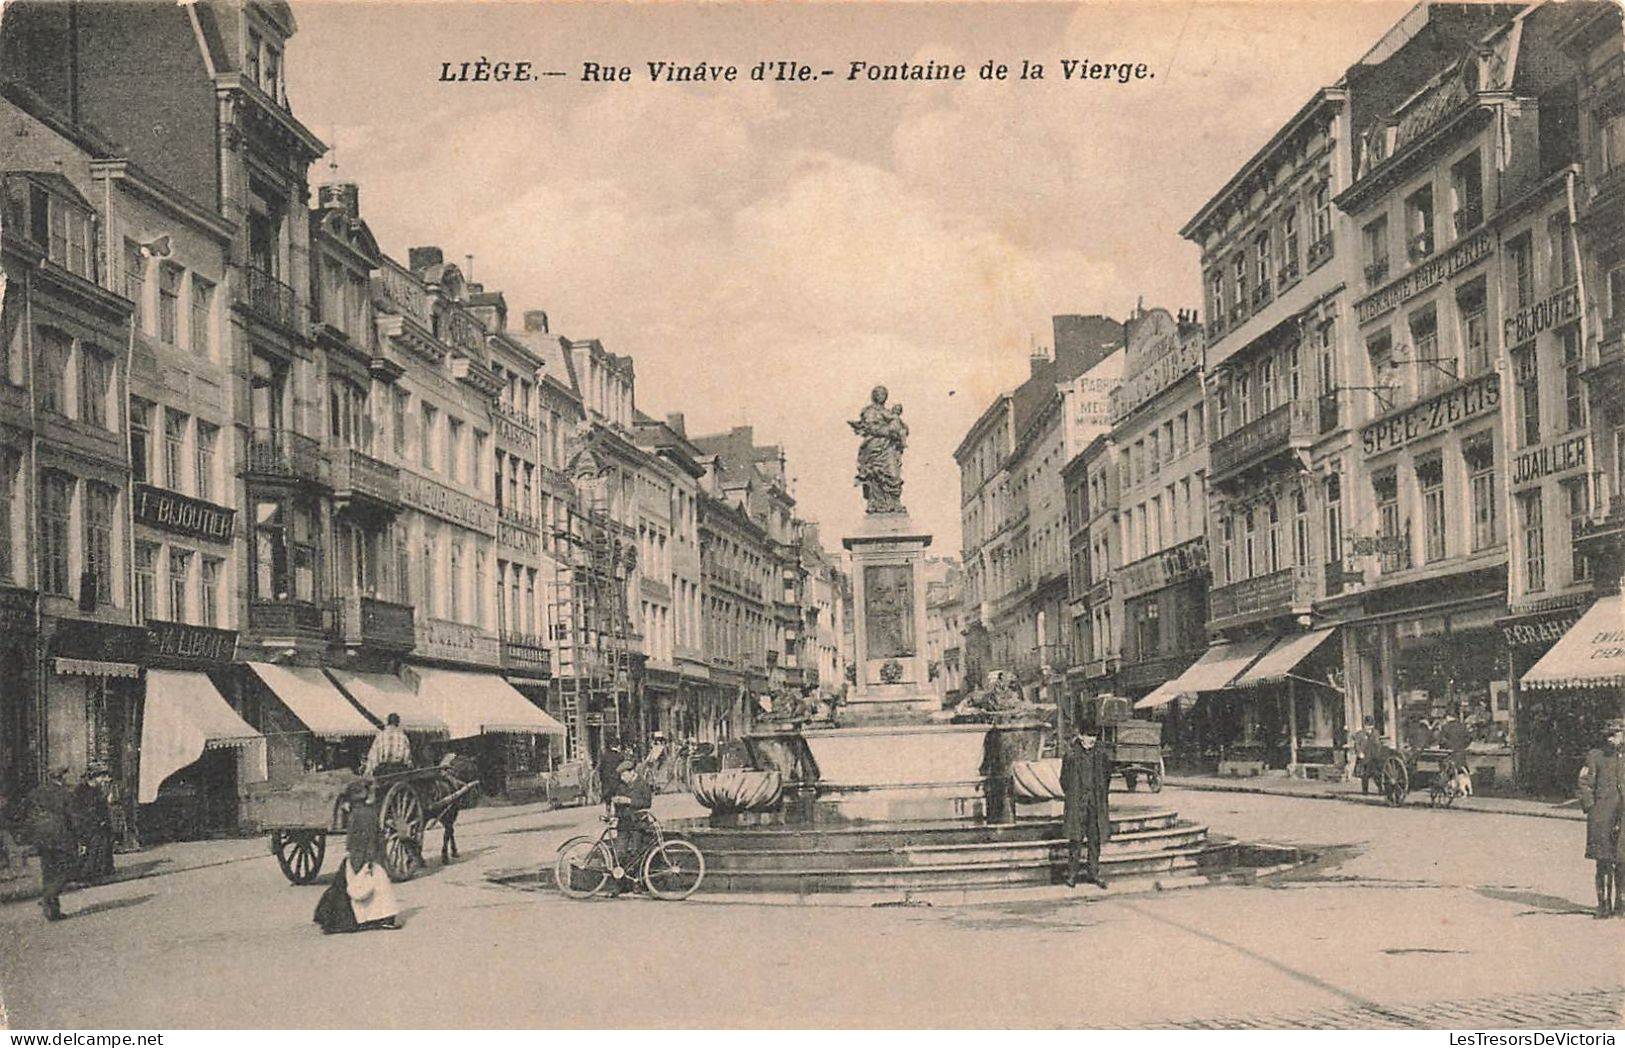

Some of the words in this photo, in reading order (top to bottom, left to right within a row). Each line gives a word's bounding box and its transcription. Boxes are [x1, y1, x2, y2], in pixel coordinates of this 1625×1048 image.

[1362, 373, 1500, 455] SPEE-ZELIS
[1513, 437, 1586, 485] JOAILLIER
[158, 496, 232, 539] BIJOUTIER
